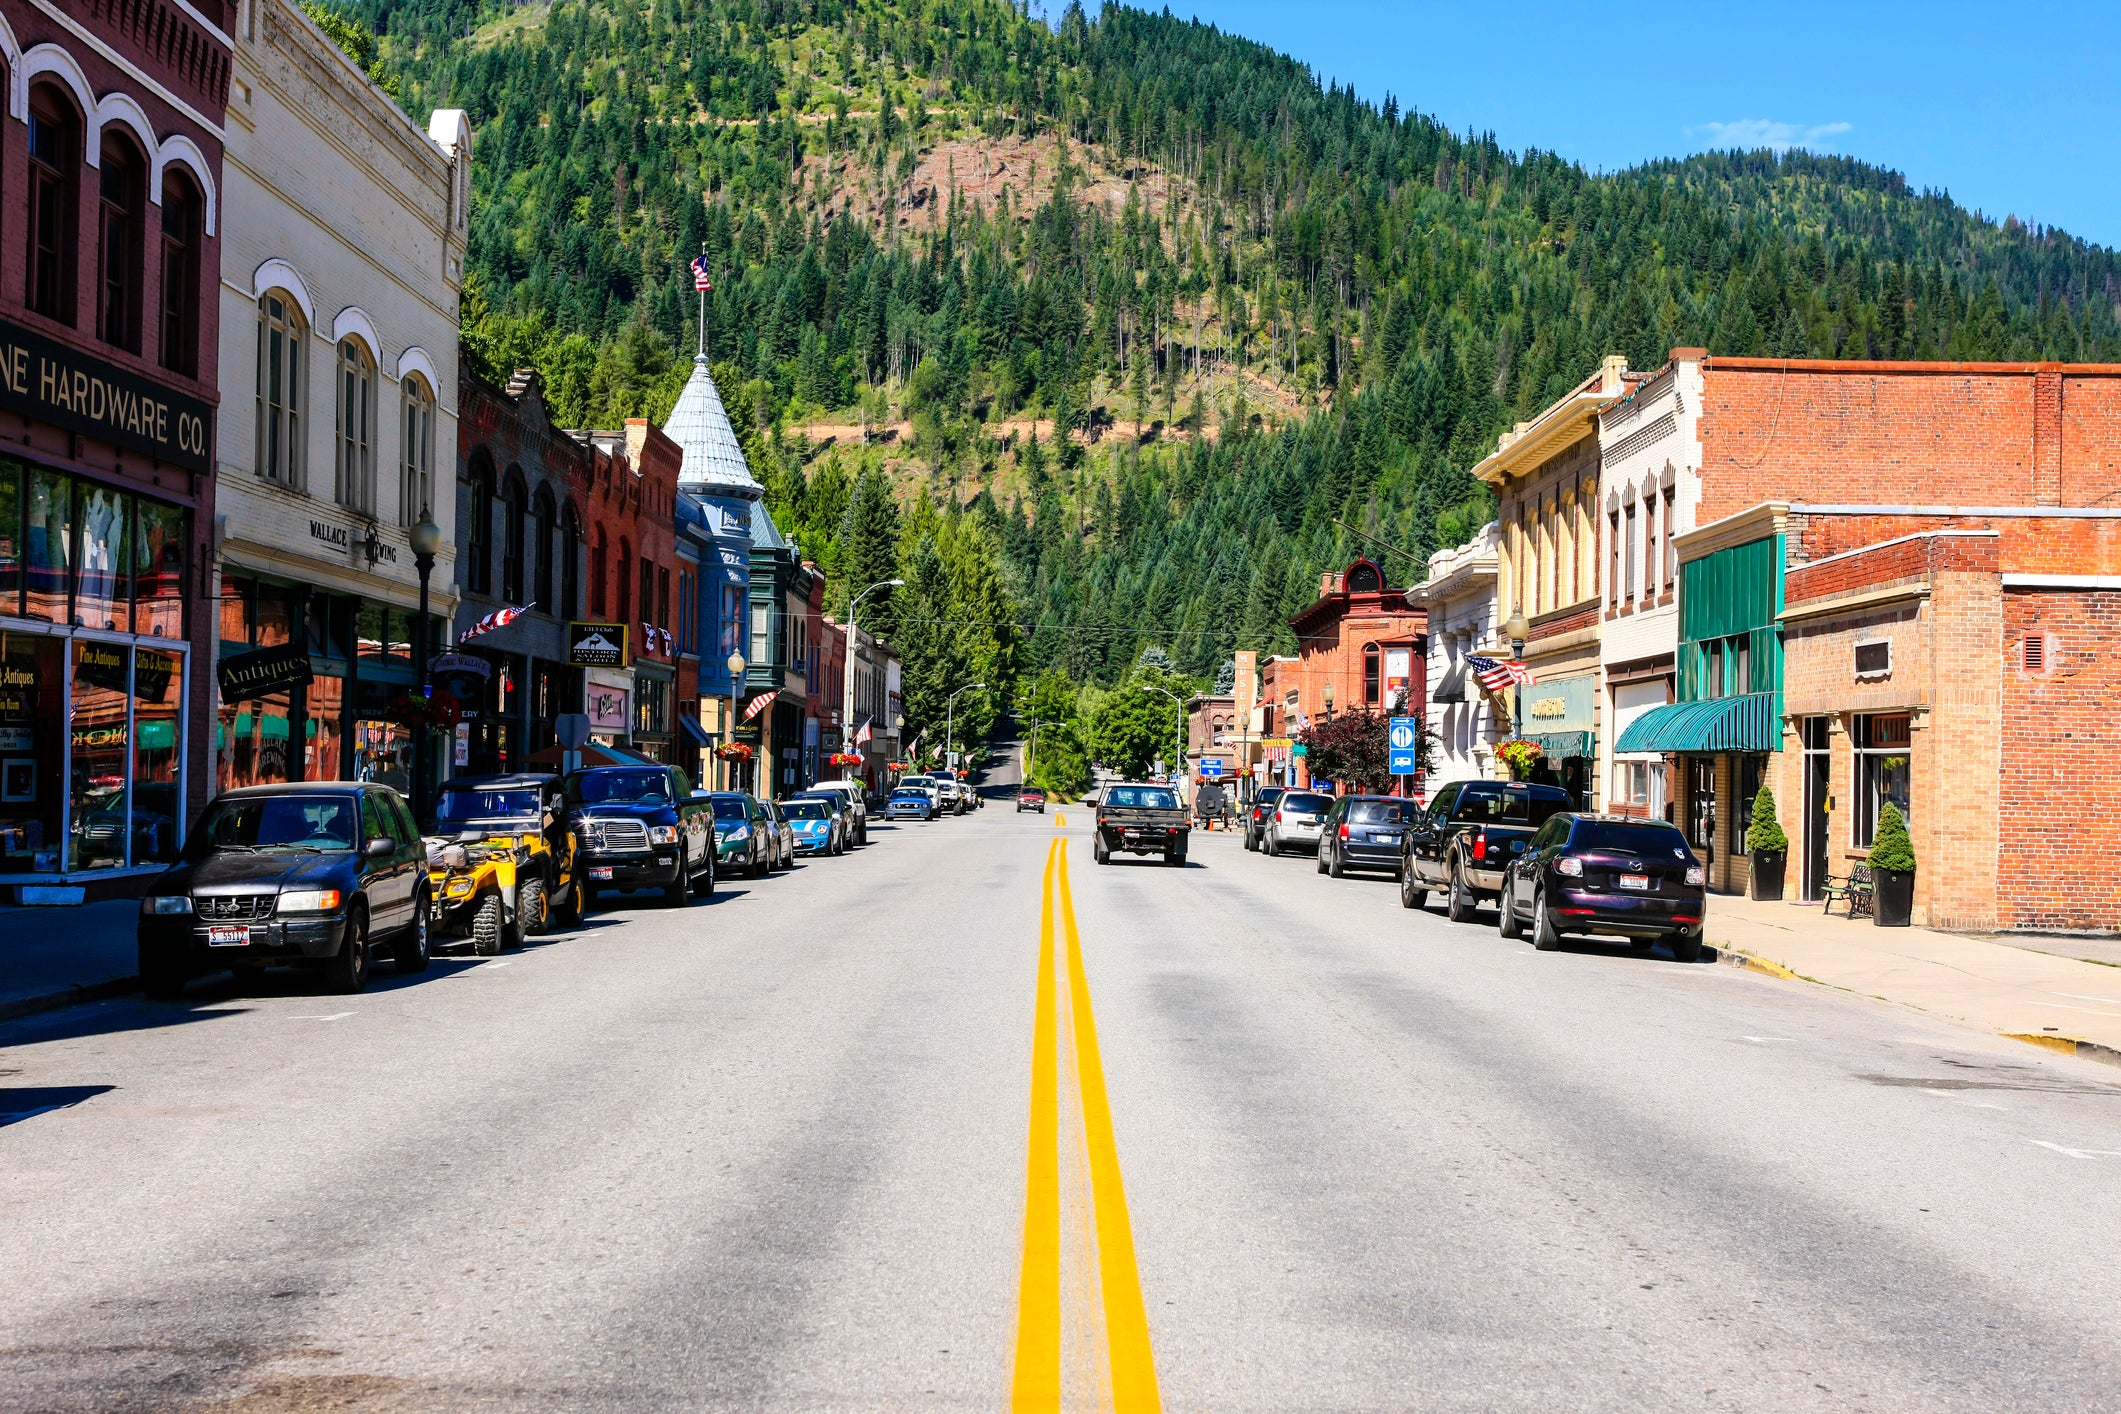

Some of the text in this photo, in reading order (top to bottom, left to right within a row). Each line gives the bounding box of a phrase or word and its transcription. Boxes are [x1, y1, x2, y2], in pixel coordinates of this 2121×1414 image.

[40, 357, 169, 444] HARDWARE
[178, 411, 206, 457] CO.
[310, 520, 347, 547] WALLACE
[94, 648, 121, 669] Antiques
[136, 653, 149, 669] Gifts
[223, 655, 308, 686] Antiques
[4, 667, 34, 689] Antiques
[1238, 654, 1248, 725] MUSEU
